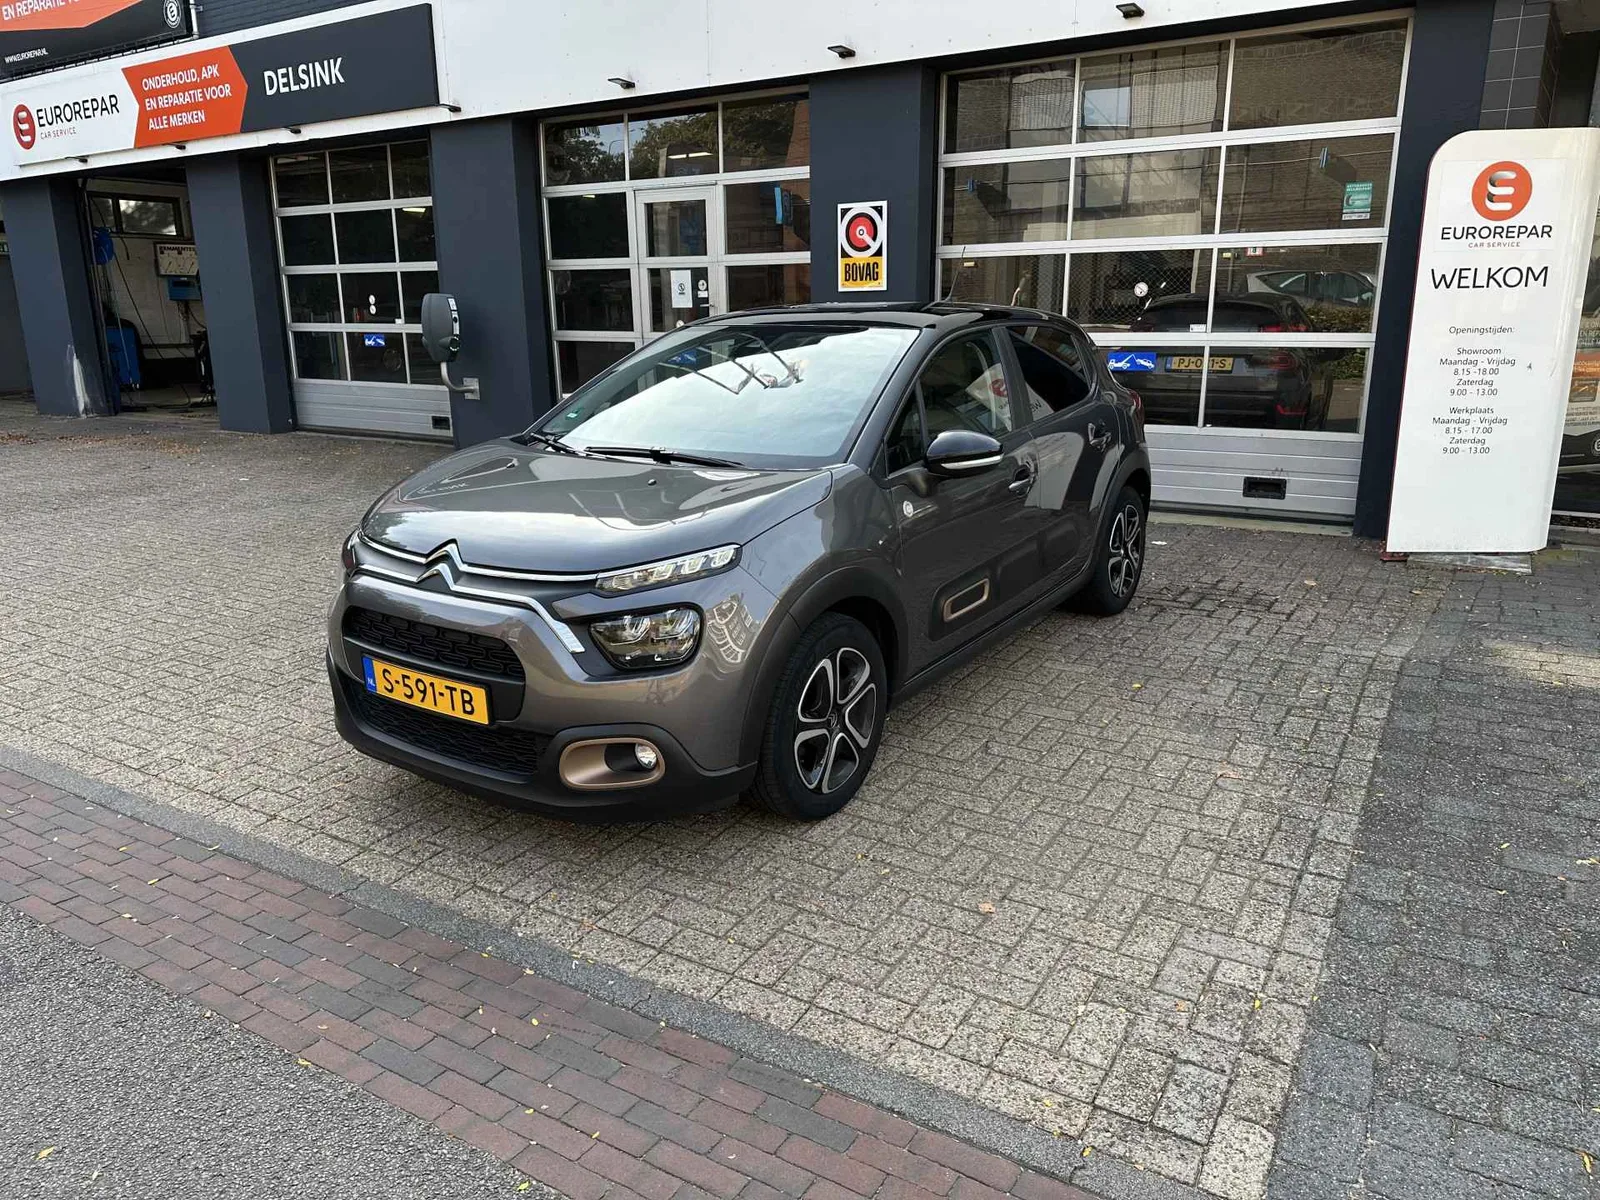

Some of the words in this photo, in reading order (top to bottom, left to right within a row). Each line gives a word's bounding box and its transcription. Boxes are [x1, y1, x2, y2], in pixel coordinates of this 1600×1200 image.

[2, 5, 15, 21] EN
[142, 68, 200, 91] ONDERHOUD,
[201, 63, 219, 80] APK
[263, 57, 345, 96] DELSINK
[145, 97, 159, 111] EN
[157, 88, 203, 109] REPARATIE
[203, 83, 232, 101] VOOR
[36, 94, 120, 127] EUROREPAR
[148, 115, 168, 131] ALLE
[169, 110, 206, 128] MERKEN
[40, 131, 52, 140] CAR
[52, 126, 77, 139] SERVICE
[1441, 225, 1553, 240] EUROREPAR
[844, 262, 879, 282] BOVAG
[1431, 266, 1549, 290] WELKOM
[1449, 326, 1515, 336] Openingstijden:
[1456, 347, 1502, 356] Showroom
[1177, 358, 1227, 369] PJ-01-S
[1439, 357, 1478, 368] Maandag
[1486, 357, 1516, 367] Vrijdag
[1453, 368, 1471, 376] 8.15
[1456, 378, 1494, 388] Zaterdag
[1450, 388, 1467, 396] 9.00
[1476, 388, 1498, 396] 13.00
[1449, 406, 1495, 416] Werkplaats
[1432, 417, 1471, 426] Maandag
[1479, 416, 1508, 426] Vrijdag
[1449, 436, 1486, 446] Zaterdag
[1442, 446, 1460, 454] 9.00
[1469, 446, 1491, 454] 13.00
[367, 677, 376, 687] NL
[382, 667, 475, 716] S-591-TB
